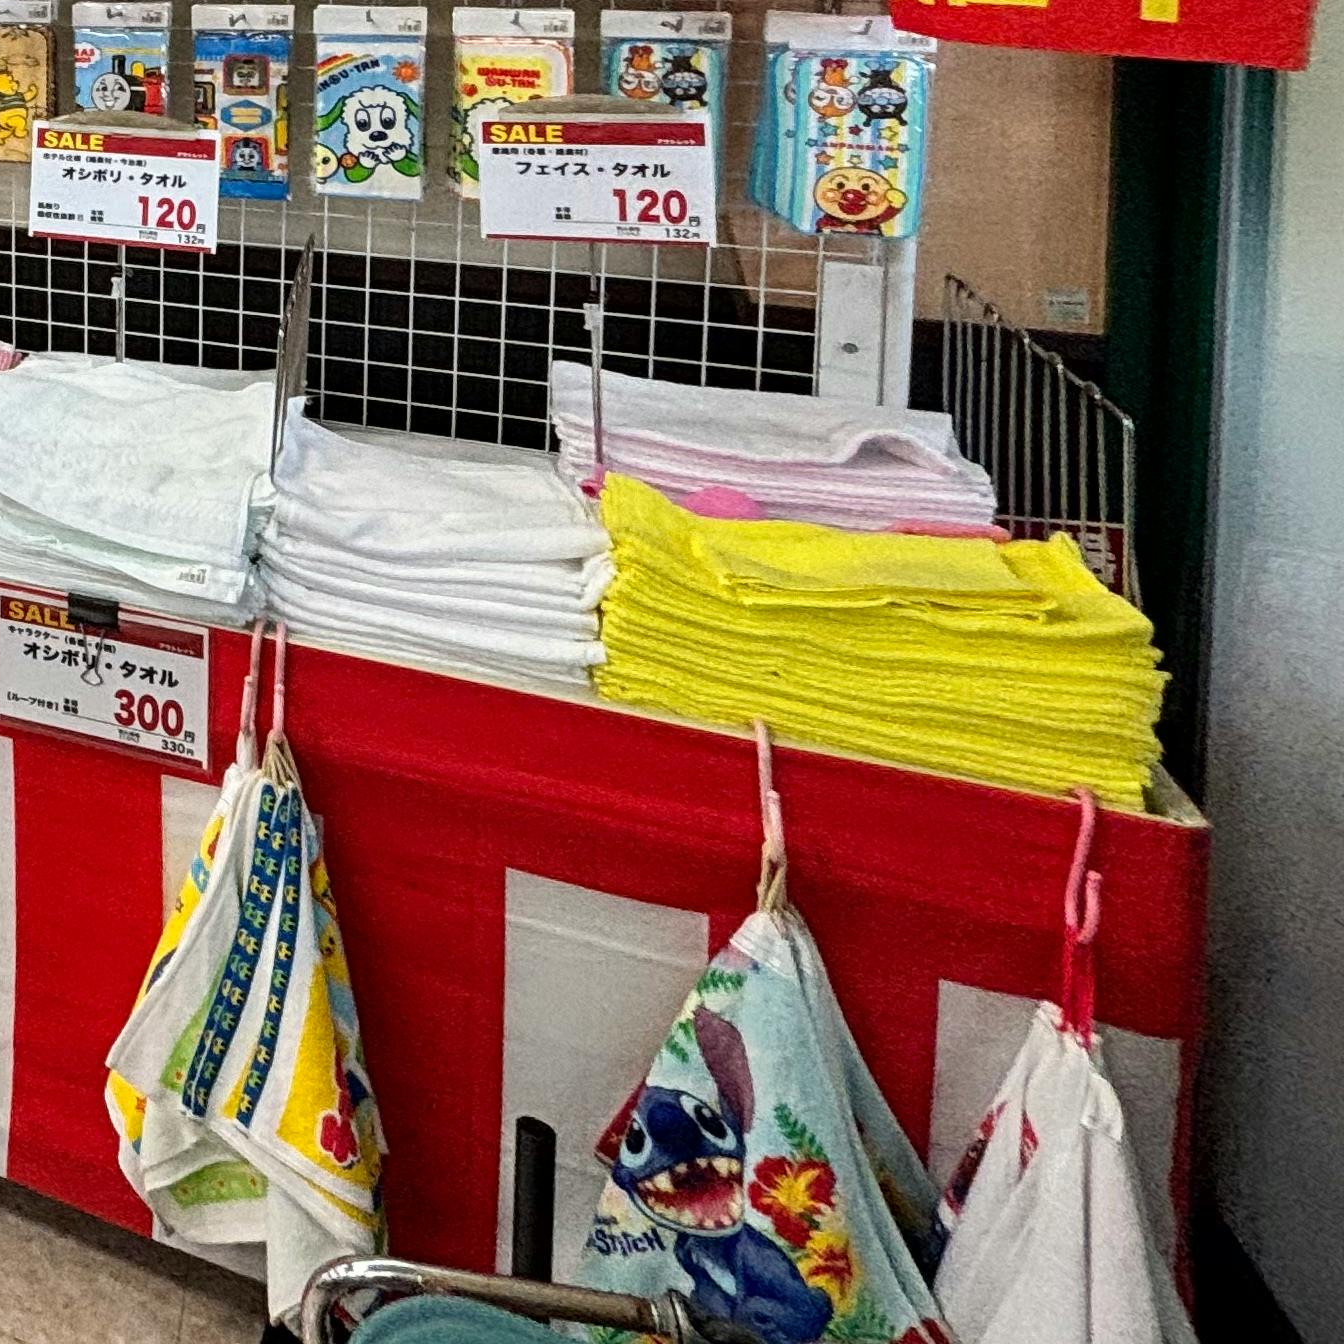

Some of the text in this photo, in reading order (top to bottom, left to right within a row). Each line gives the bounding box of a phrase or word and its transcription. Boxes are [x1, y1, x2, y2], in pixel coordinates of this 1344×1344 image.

[43, 131, 104, 151] SALE
[489, 124, 563, 143] SALE
[62, 166, 187, 189] オシボリ・タオル
[515, 161, 671, 178] フェイス・タオル
[23, 641, 180, 688] オシボリ・タオル
